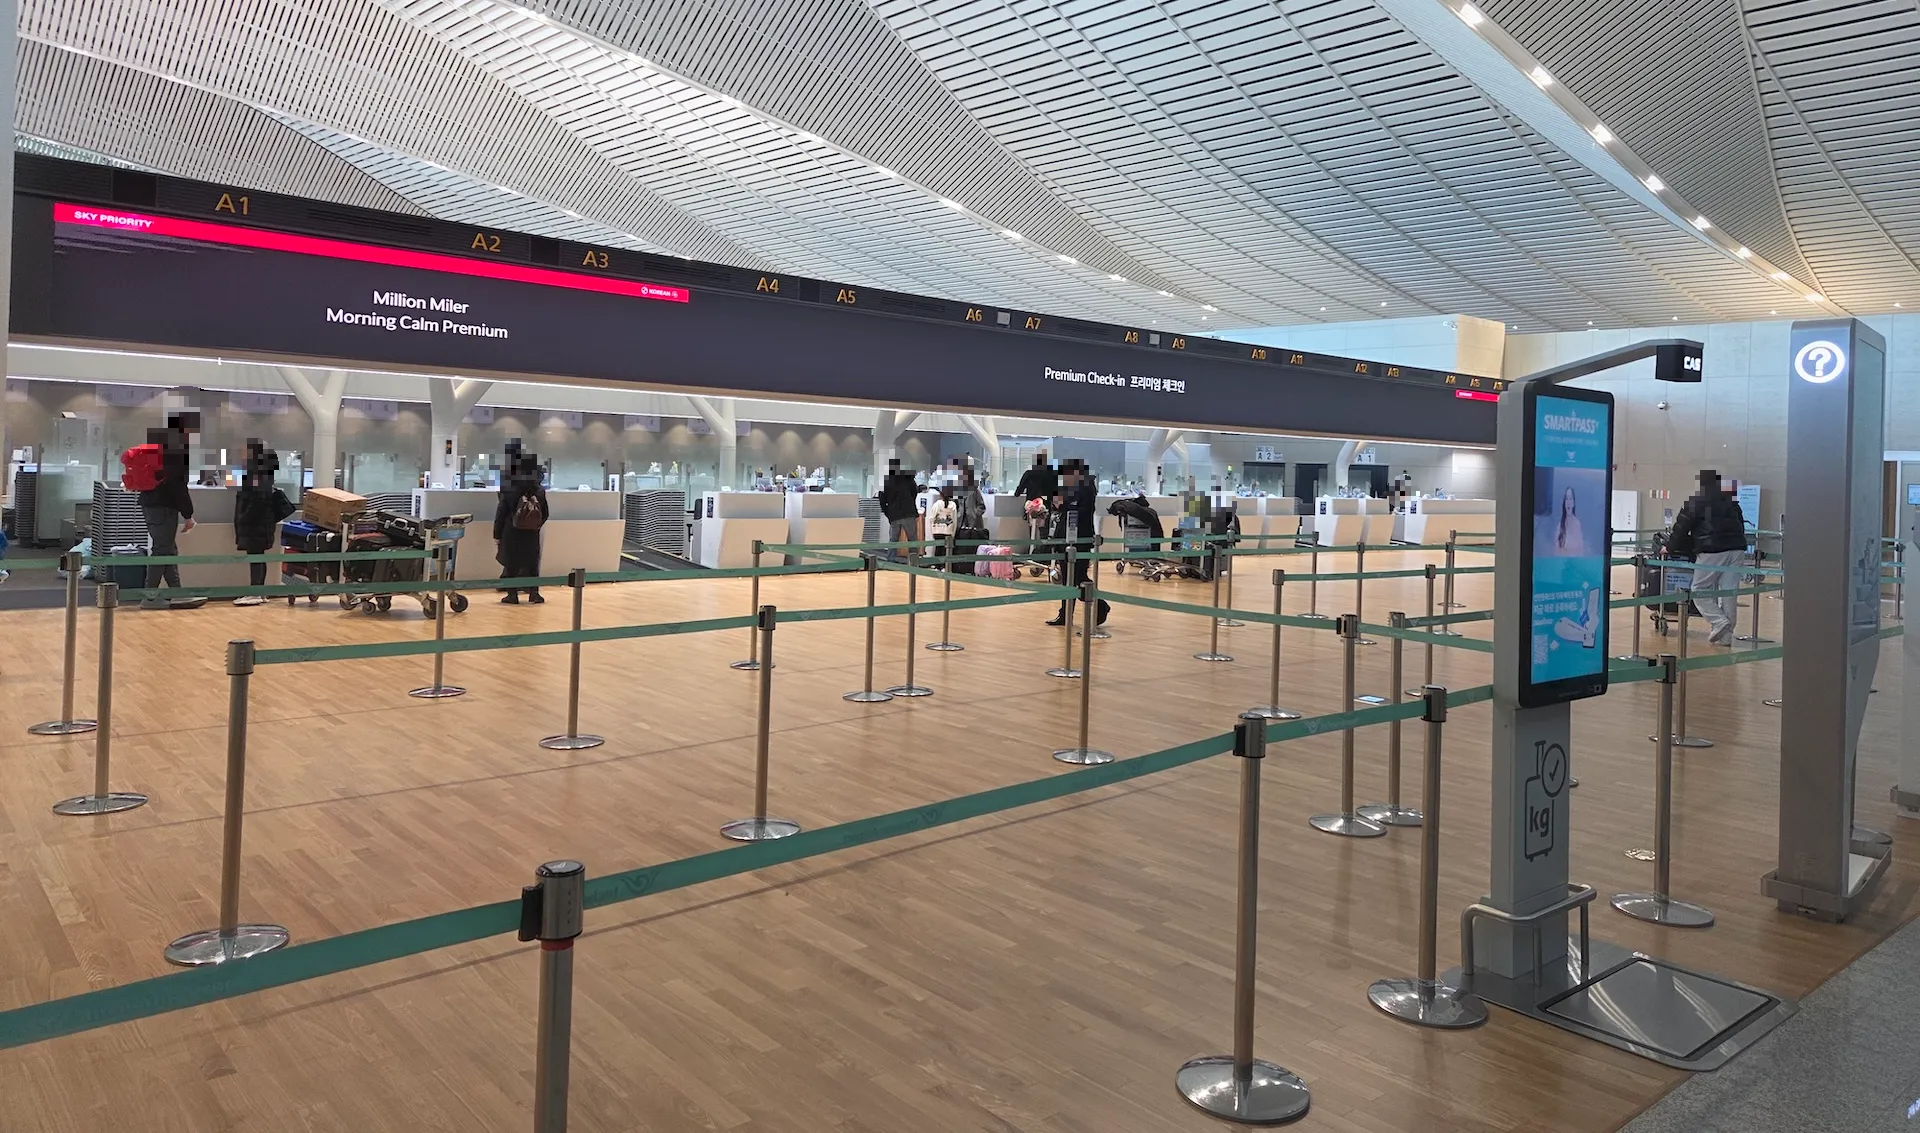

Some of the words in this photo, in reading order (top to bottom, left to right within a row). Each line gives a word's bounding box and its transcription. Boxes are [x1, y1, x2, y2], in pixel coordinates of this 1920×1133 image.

[214, 193, 249, 215] A1
[74, 210, 98, 221] SKY
[99, 213, 152, 228] PRIORITY
[471, 232, 501, 253] A2
[582, 250, 609, 269] A3
[649, 288, 671, 297] KOREAN
[756, 276, 780, 293] A4
[373, 290, 426, 310] Million
[430, 296, 469, 314] Miler
[836, 289, 856, 304] A5
[326, 307, 397, 331] Morning
[399, 315, 439, 332] Calm
[442, 319, 508, 338] Premium
[965, 308, 983, 323] A6
[1025, 316, 1041, 330] A7
[1124, 330, 1139, 344] A8
[1172, 338, 1186, 350] A9
[1251, 348, 1266, 360] A10
[1290, 354, 1303, 365] A11
[1044, 366, 1086, 383] Premium
[1087, 371, 1125, 387] Check-in
[1130, 375, 1161, 392] 프리미엄
[1162, 379, 1185, 394] 체크인
[1543, 414, 1597, 434] SMARTPASS
[1529, 805, 1550, 838] kg
